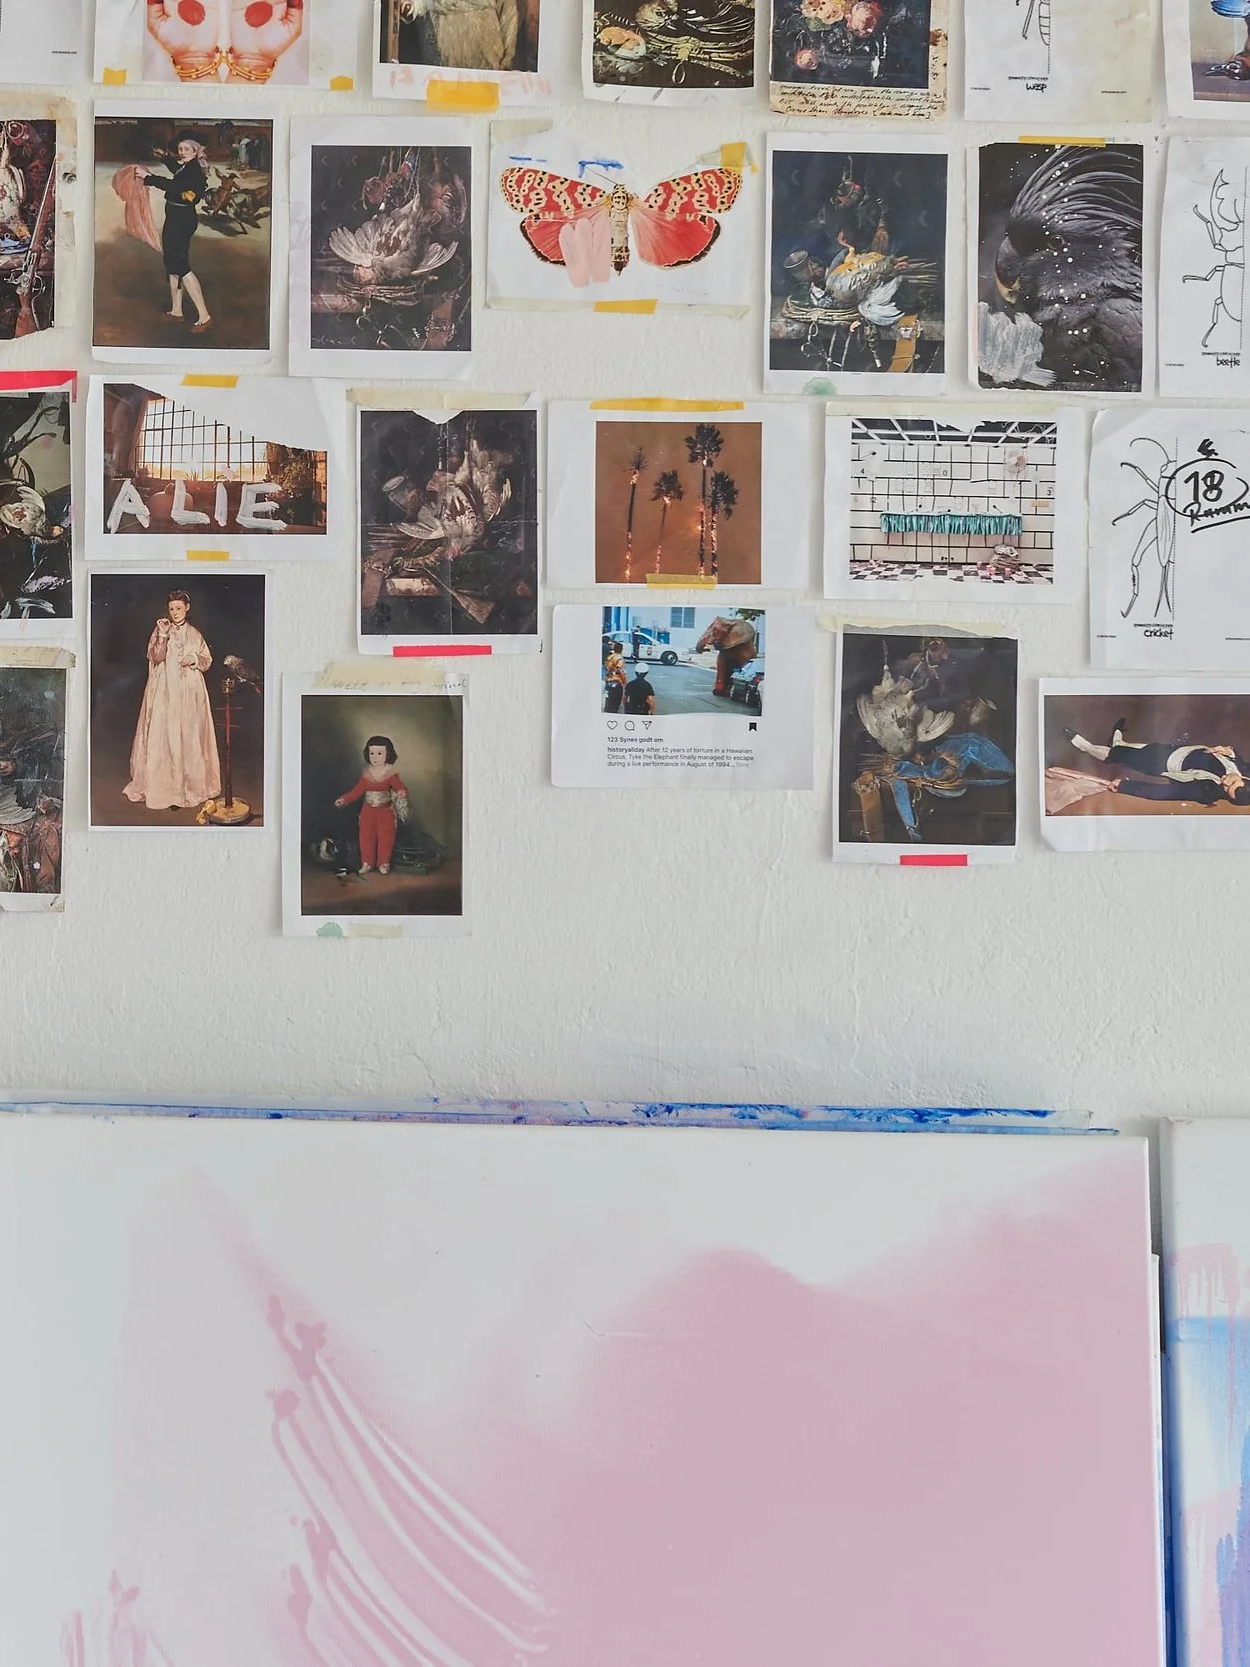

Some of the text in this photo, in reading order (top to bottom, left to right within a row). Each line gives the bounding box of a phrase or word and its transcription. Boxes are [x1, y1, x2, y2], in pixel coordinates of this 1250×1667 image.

[1216, 356, 1240, 368] beetle
[1183, 469, 1225, 503] 18
[106, 478, 288, 534] A LIE
[1143, 628, 1174, 640] cricket
[643, 753, 654, 761] the
[679, 754, 697, 762] finally
[642, 761, 679, 769] performance
[686, 761, 707, 769] August
